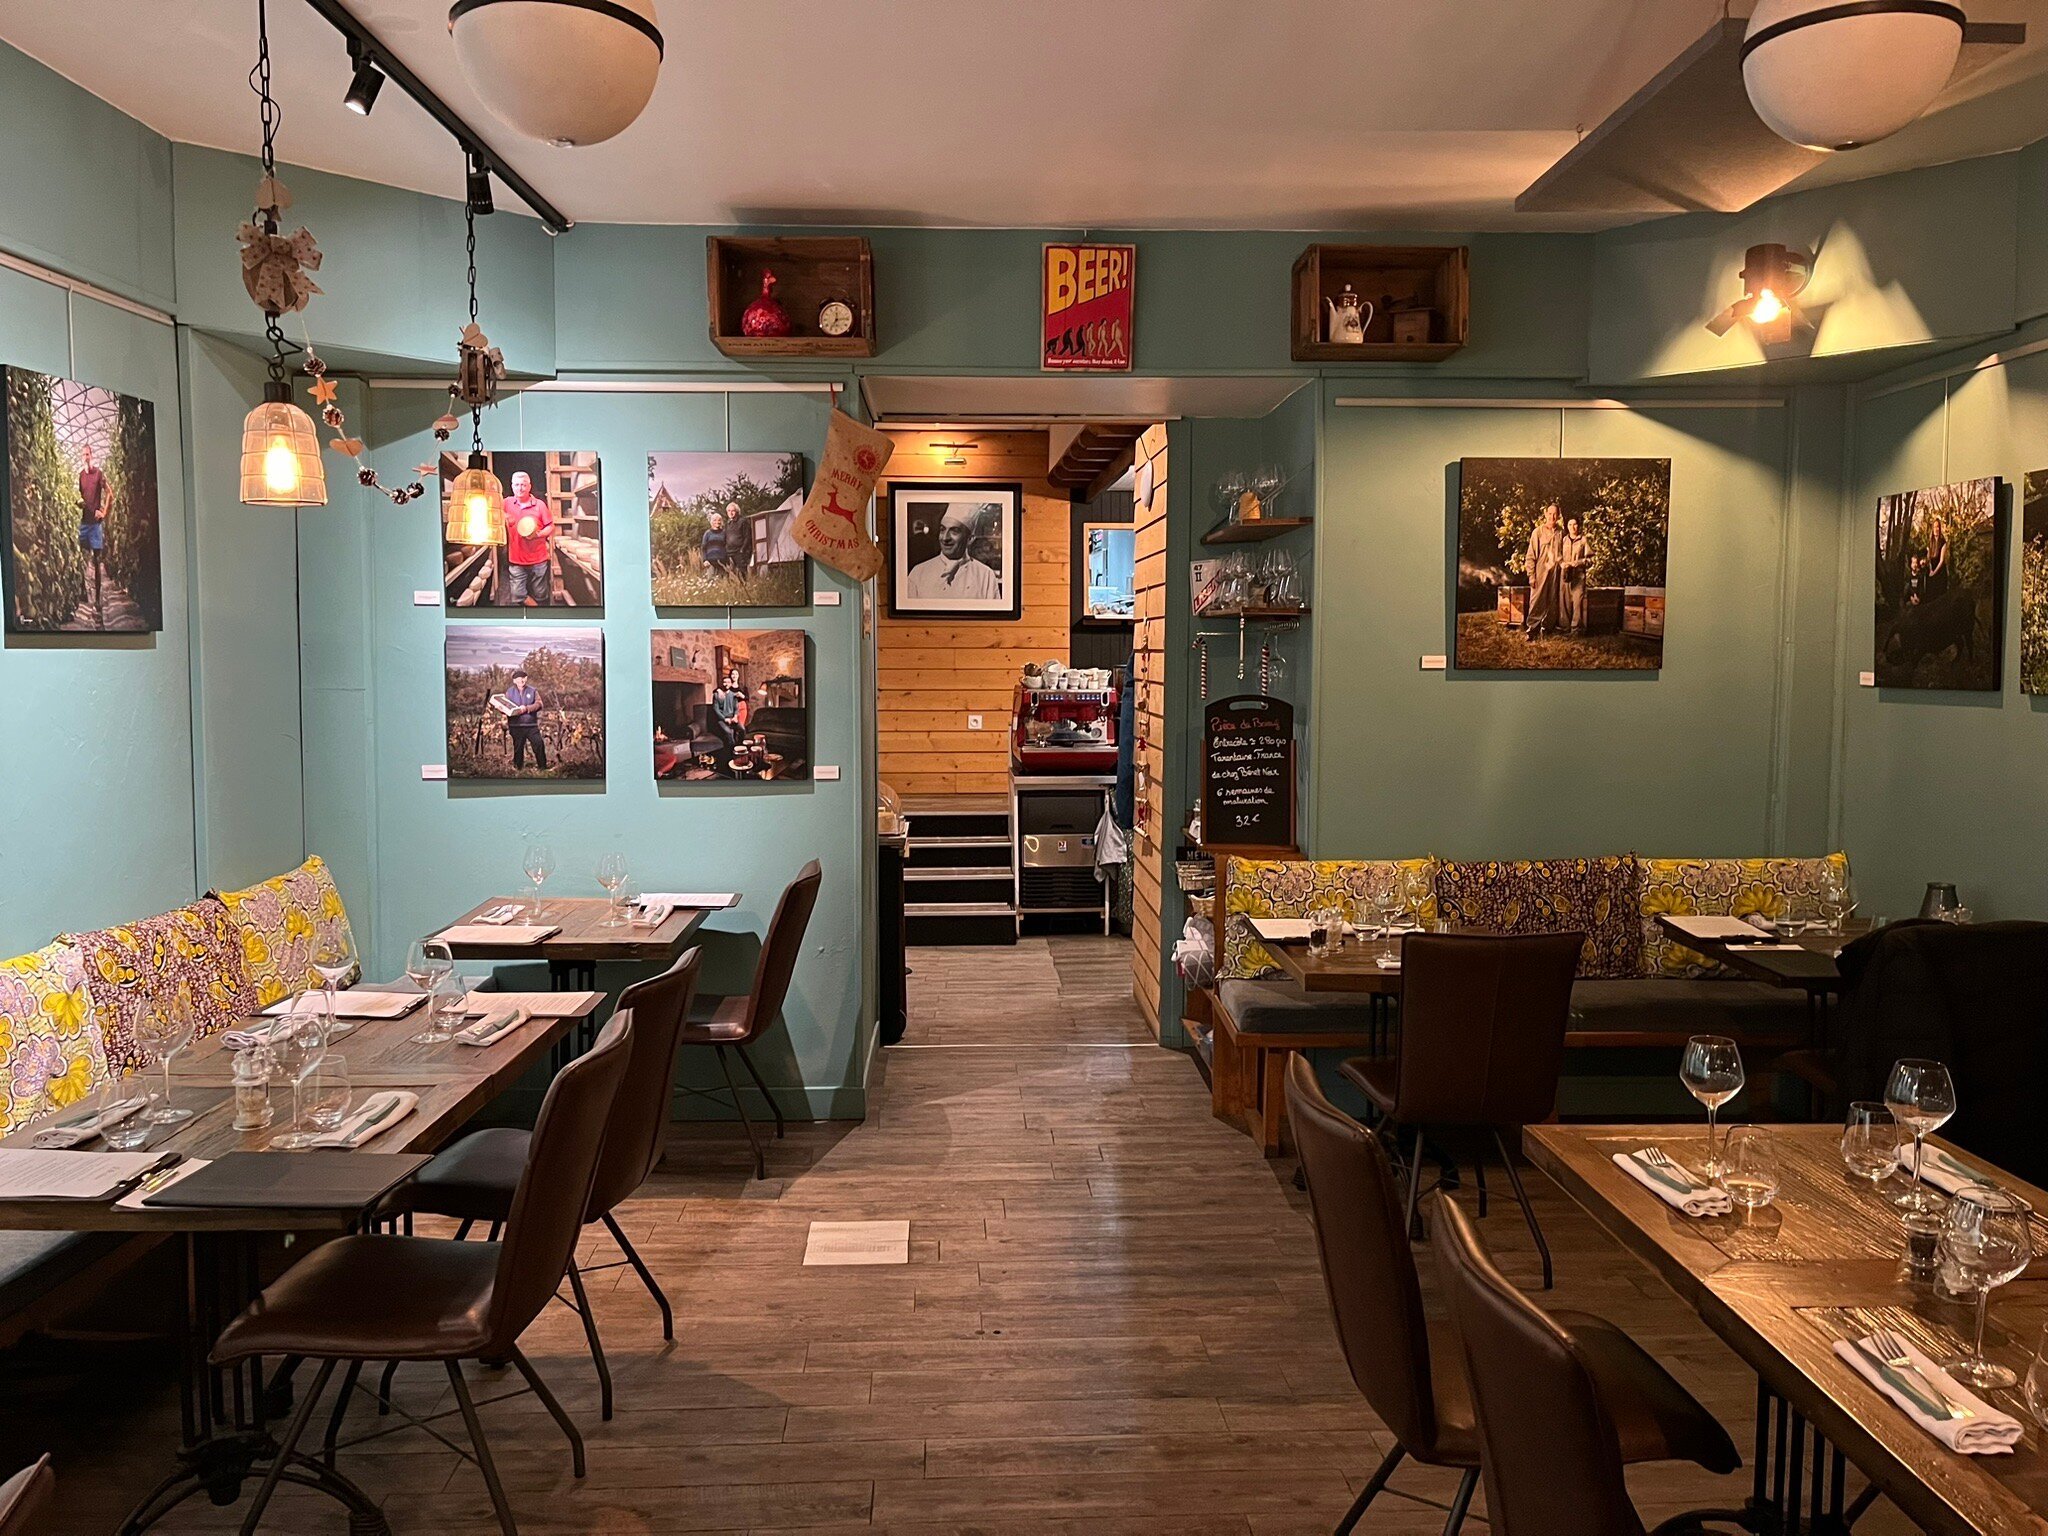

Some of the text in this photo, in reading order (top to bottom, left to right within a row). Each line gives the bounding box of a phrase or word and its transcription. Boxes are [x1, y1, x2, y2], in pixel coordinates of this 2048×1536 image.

[1048, 248, 1128, 316] BEER!
[831, 468, 864, 491] MERRY
[805, 519, 860, 550] CHRISTMAS
[1216, 787, 1224, 797] 6
[1225, 787, 1263, 796] semaines
[1222, 795, 1269, 806] maturation
